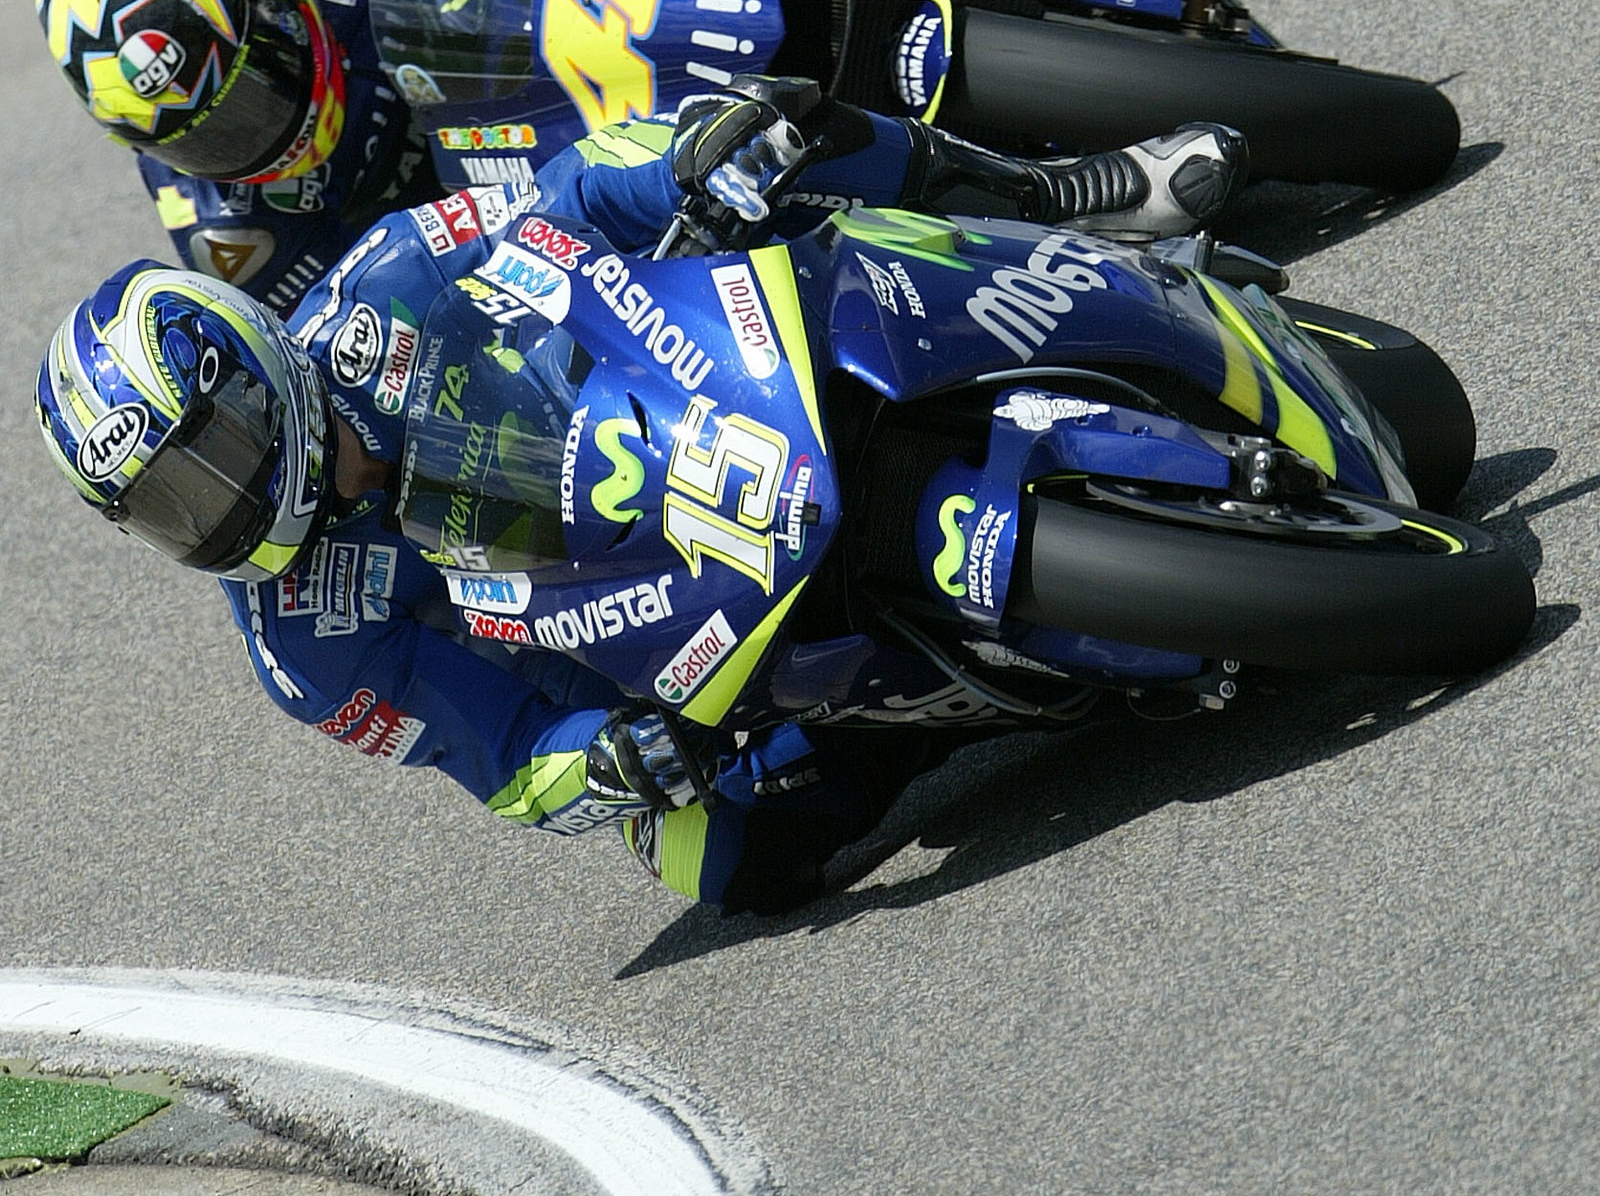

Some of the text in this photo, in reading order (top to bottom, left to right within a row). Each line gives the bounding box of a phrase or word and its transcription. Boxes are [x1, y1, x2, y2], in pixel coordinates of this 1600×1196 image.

[132, 45, 179, 95] agv
[910, 15, 942, 107] YAMAHA
[459, 157, 535, 185] YAMAHA
[472, 292, 535, 326] 15
[721, 276, 768, 348] Castrol
[888, 261, 926, 319] HONDA
[339, 308, 371, 381] Arai
[384, 329, 416, 393] Castrol
[434, 363, 470, 421] 74
[87, 408, 136, 476] Arai
[559, 404, 591, 526] HONDA
[663, 393, 791, 597] 15
[451, 545, 492, 572] 15
[966, 503, 998, 605] movistar
[979, 510, 1012, 610] HONDA
[534, 574, 673, 652] movistar
[672, 626, 727, 688] Castrol
